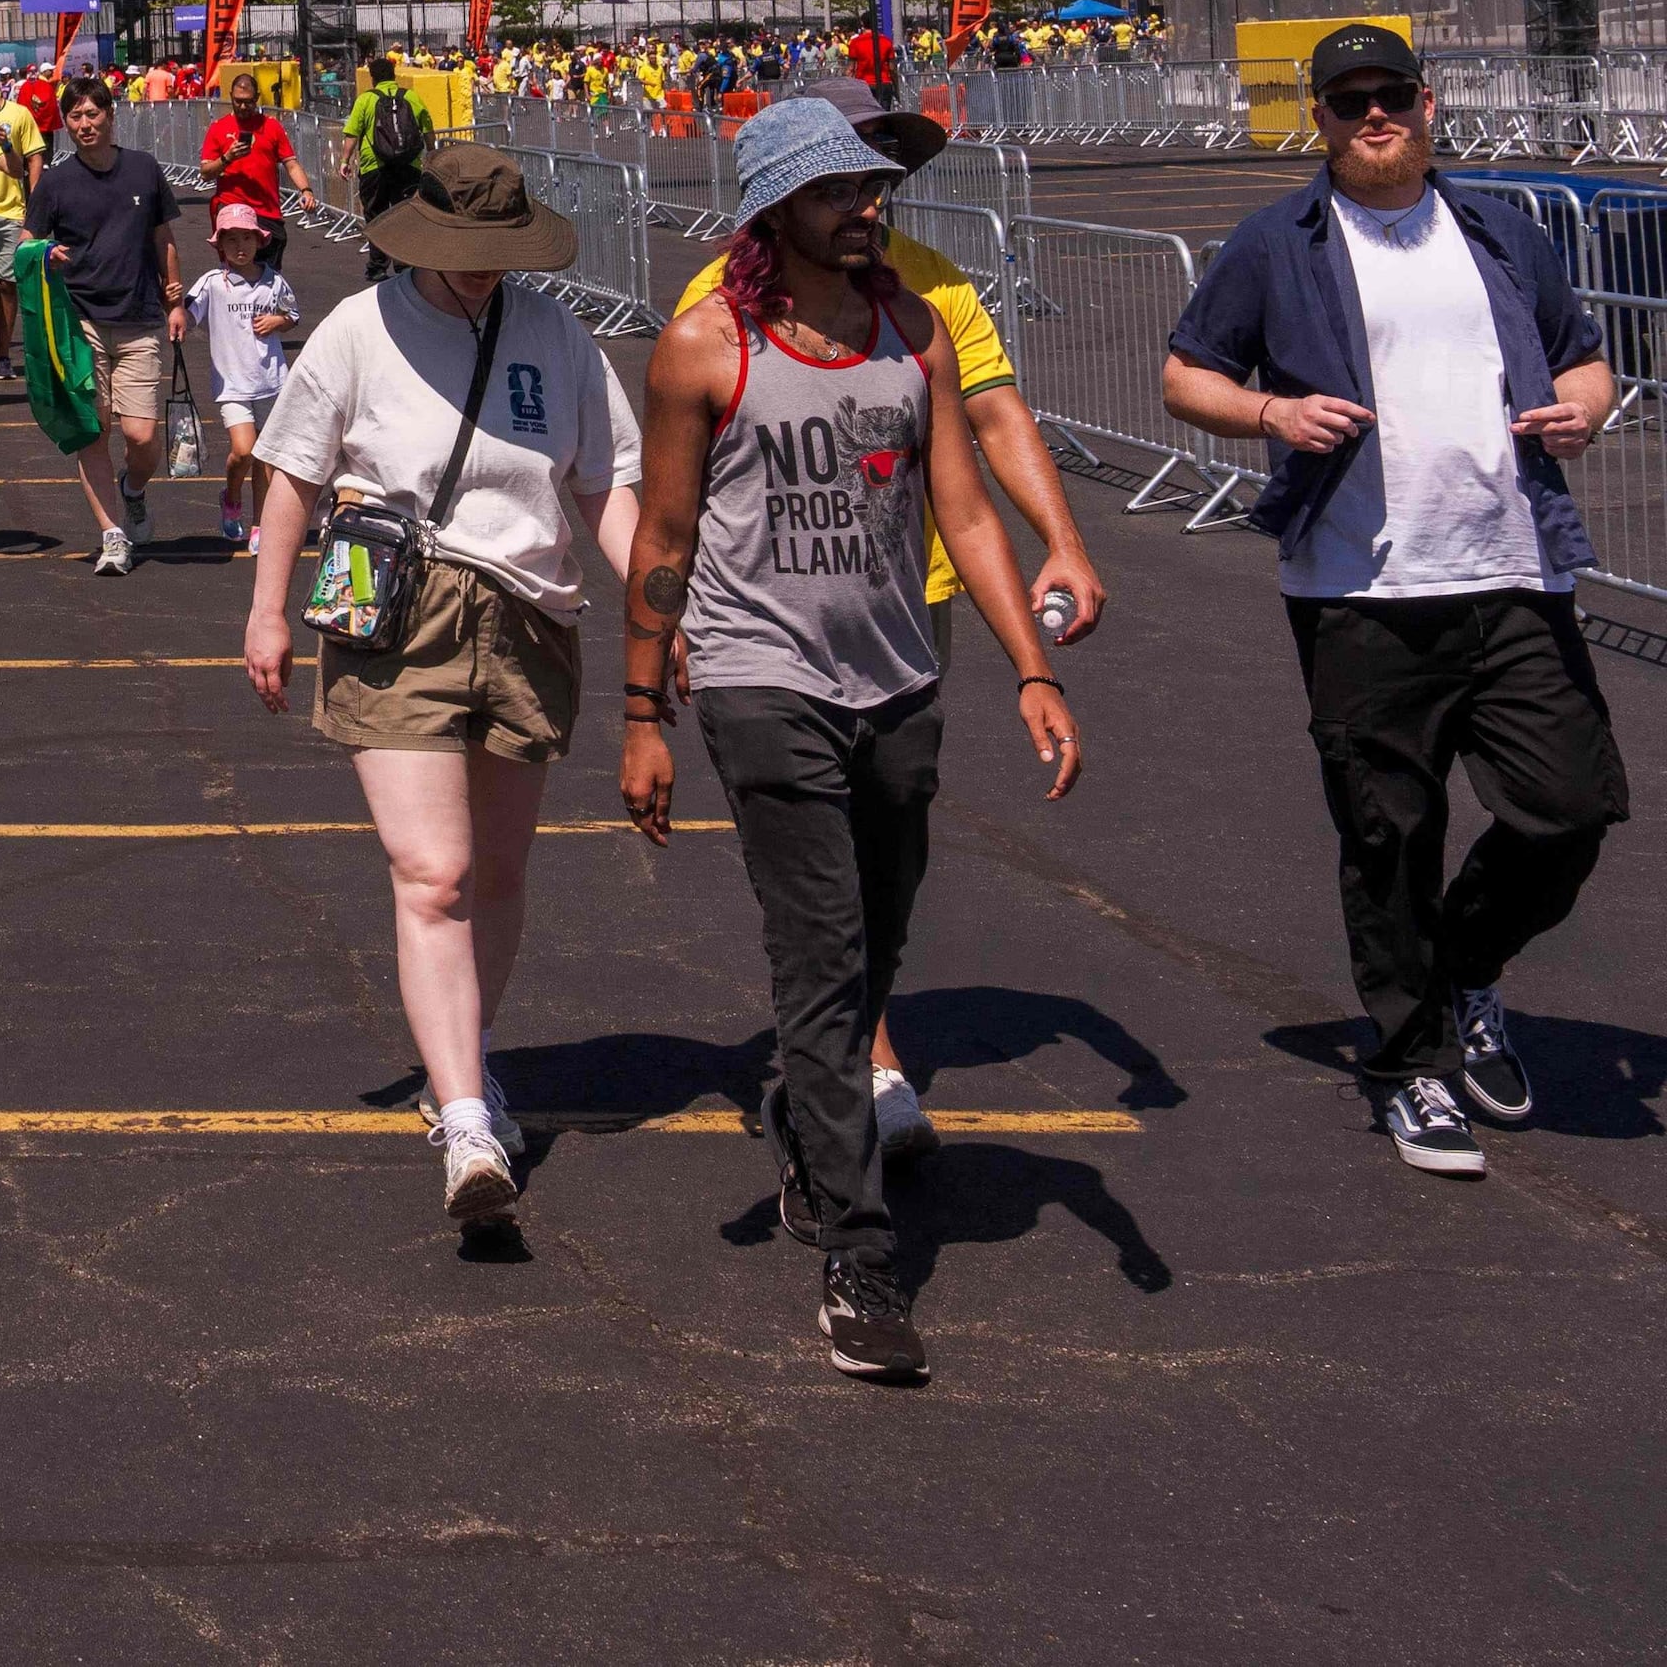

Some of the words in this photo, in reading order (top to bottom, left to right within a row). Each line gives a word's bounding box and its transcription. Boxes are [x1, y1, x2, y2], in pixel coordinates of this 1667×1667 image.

[755, 417, 840, 489] NO
[765, 490, 869, 532] PROB-
[771, 533, 880, 575] LLAMA
